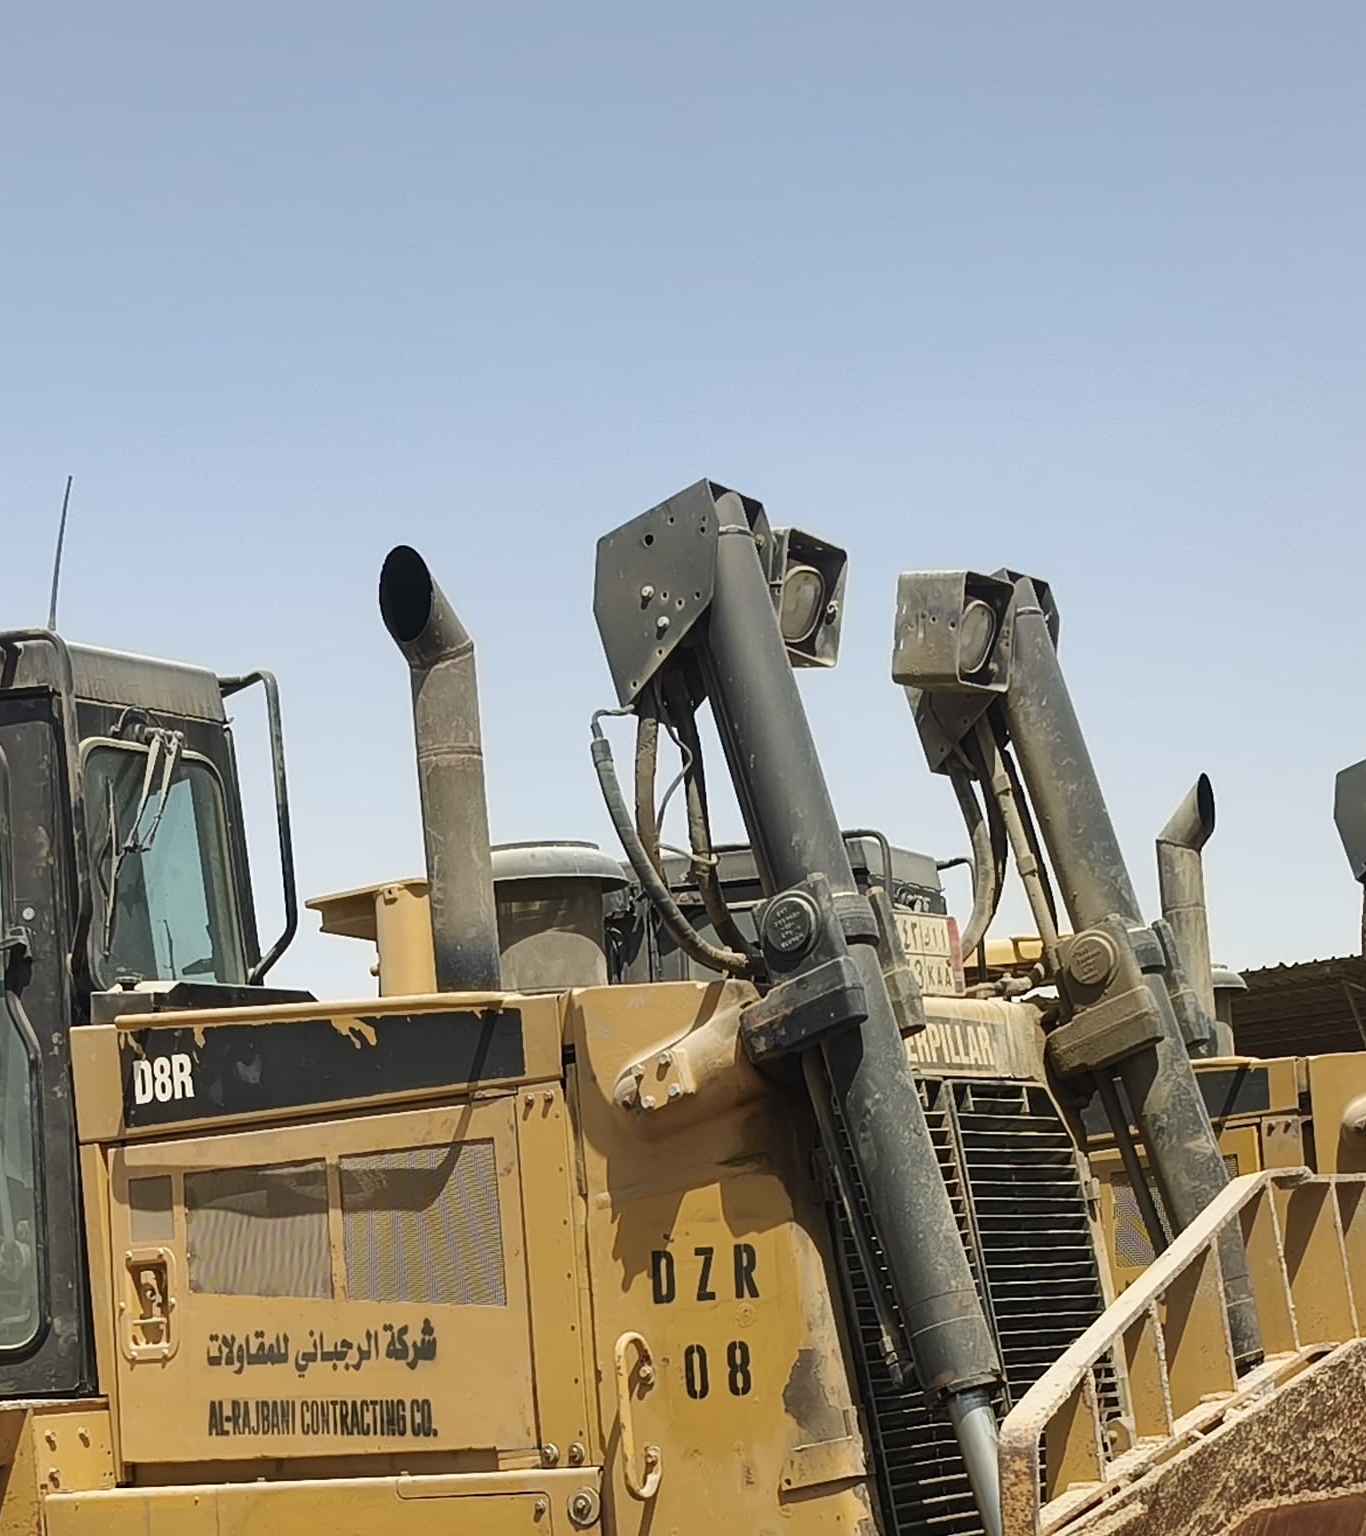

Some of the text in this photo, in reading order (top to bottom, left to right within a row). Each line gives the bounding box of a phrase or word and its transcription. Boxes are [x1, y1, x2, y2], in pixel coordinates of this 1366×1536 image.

[133, 1053, 195, 1105] D8R
[650, 1243, 760, 1305] DZR
[206, 1317, 438, 1378] شركة الرجباني للمقاولات
[684, 1340, 752, 1400] 08
[208, 1398, 439, 1438] AL-RAJBANI CONTRACTING CO.
